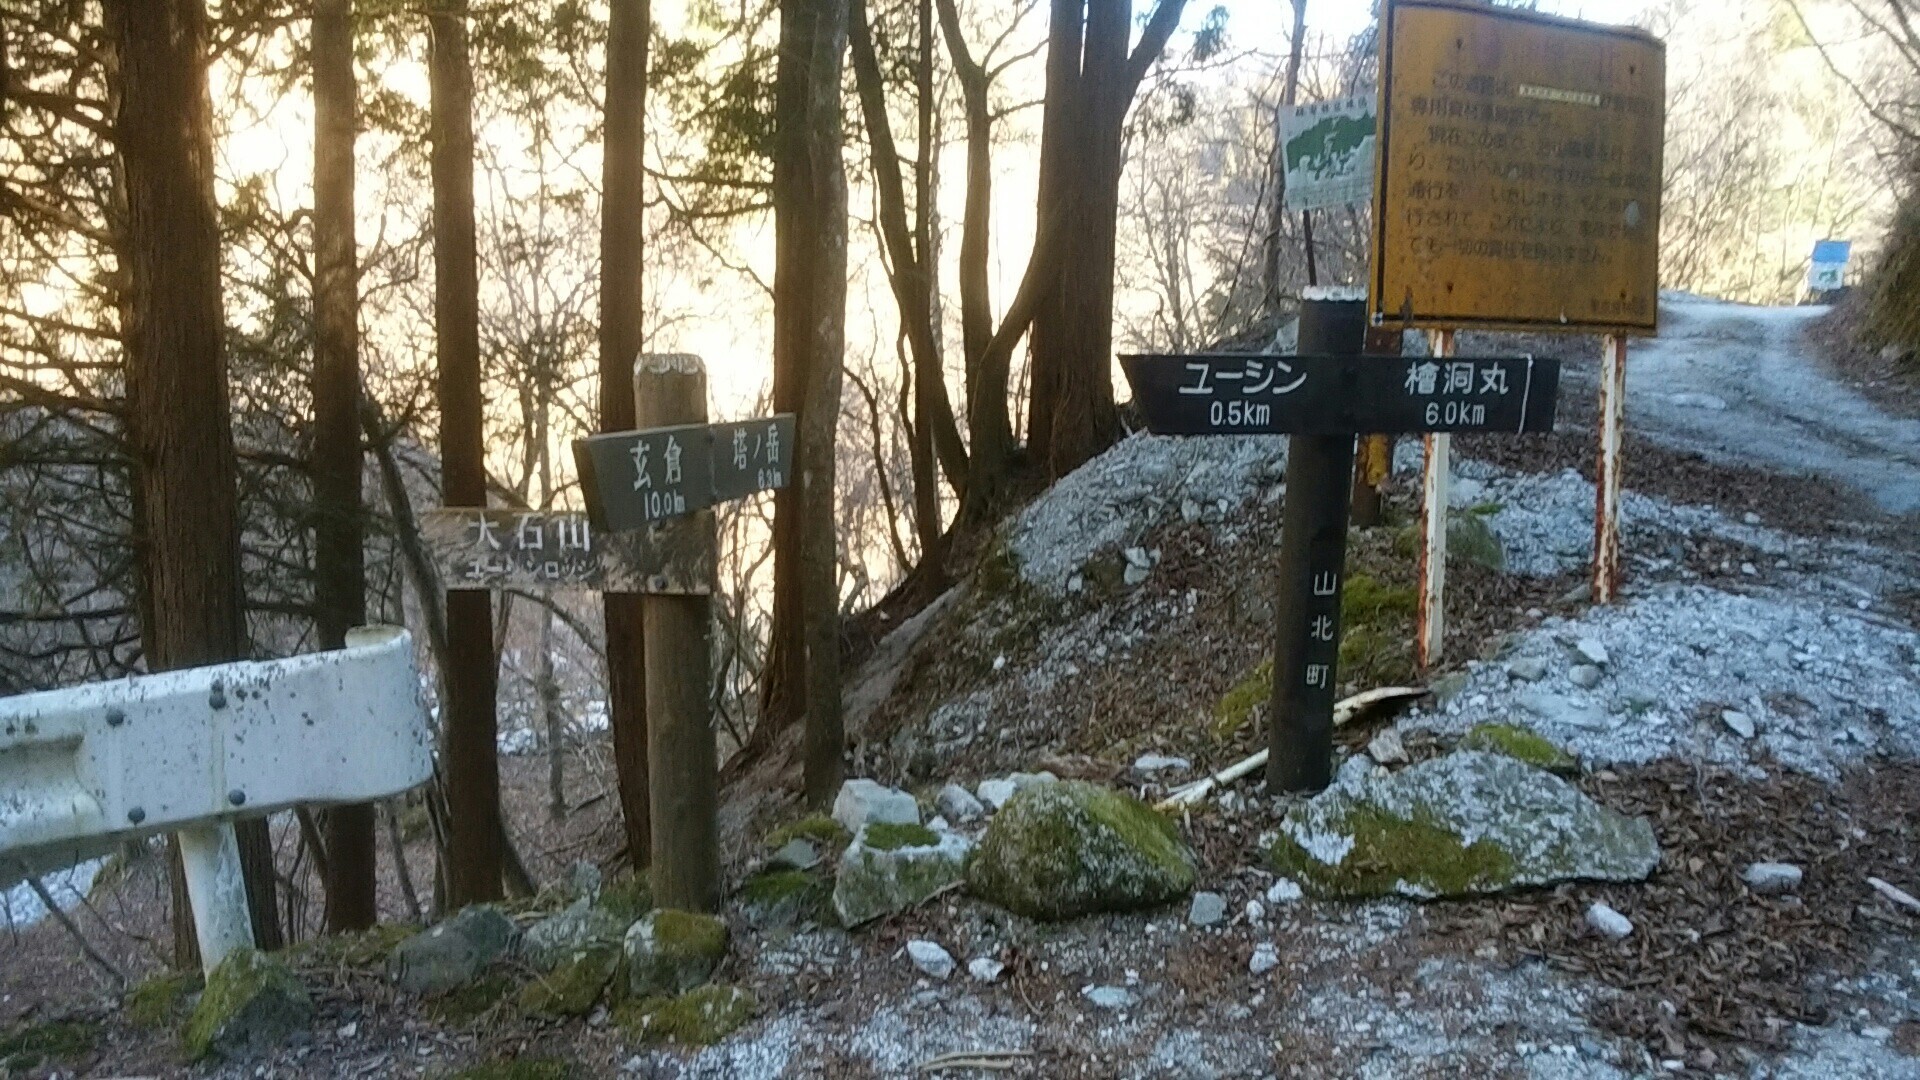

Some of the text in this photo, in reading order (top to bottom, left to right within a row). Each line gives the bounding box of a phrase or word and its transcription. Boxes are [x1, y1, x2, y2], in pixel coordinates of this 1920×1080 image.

[1178, 361, 1309, 396] ユーシン
[1404, 361, 1510, 397] 檜洞丸
[1210, 400, 1270, 427] 0.5km
[1425, 400, 1486, 427] 6.0km
[629, 434, 682, 492] 玄倉
[733, 423, 781, 471] 塔ノ岳
[644, 490, 685, 521] 10.0km
[467, 512, 591, 554] 大石山
[1306, 570, 1337, 690] 山北町
